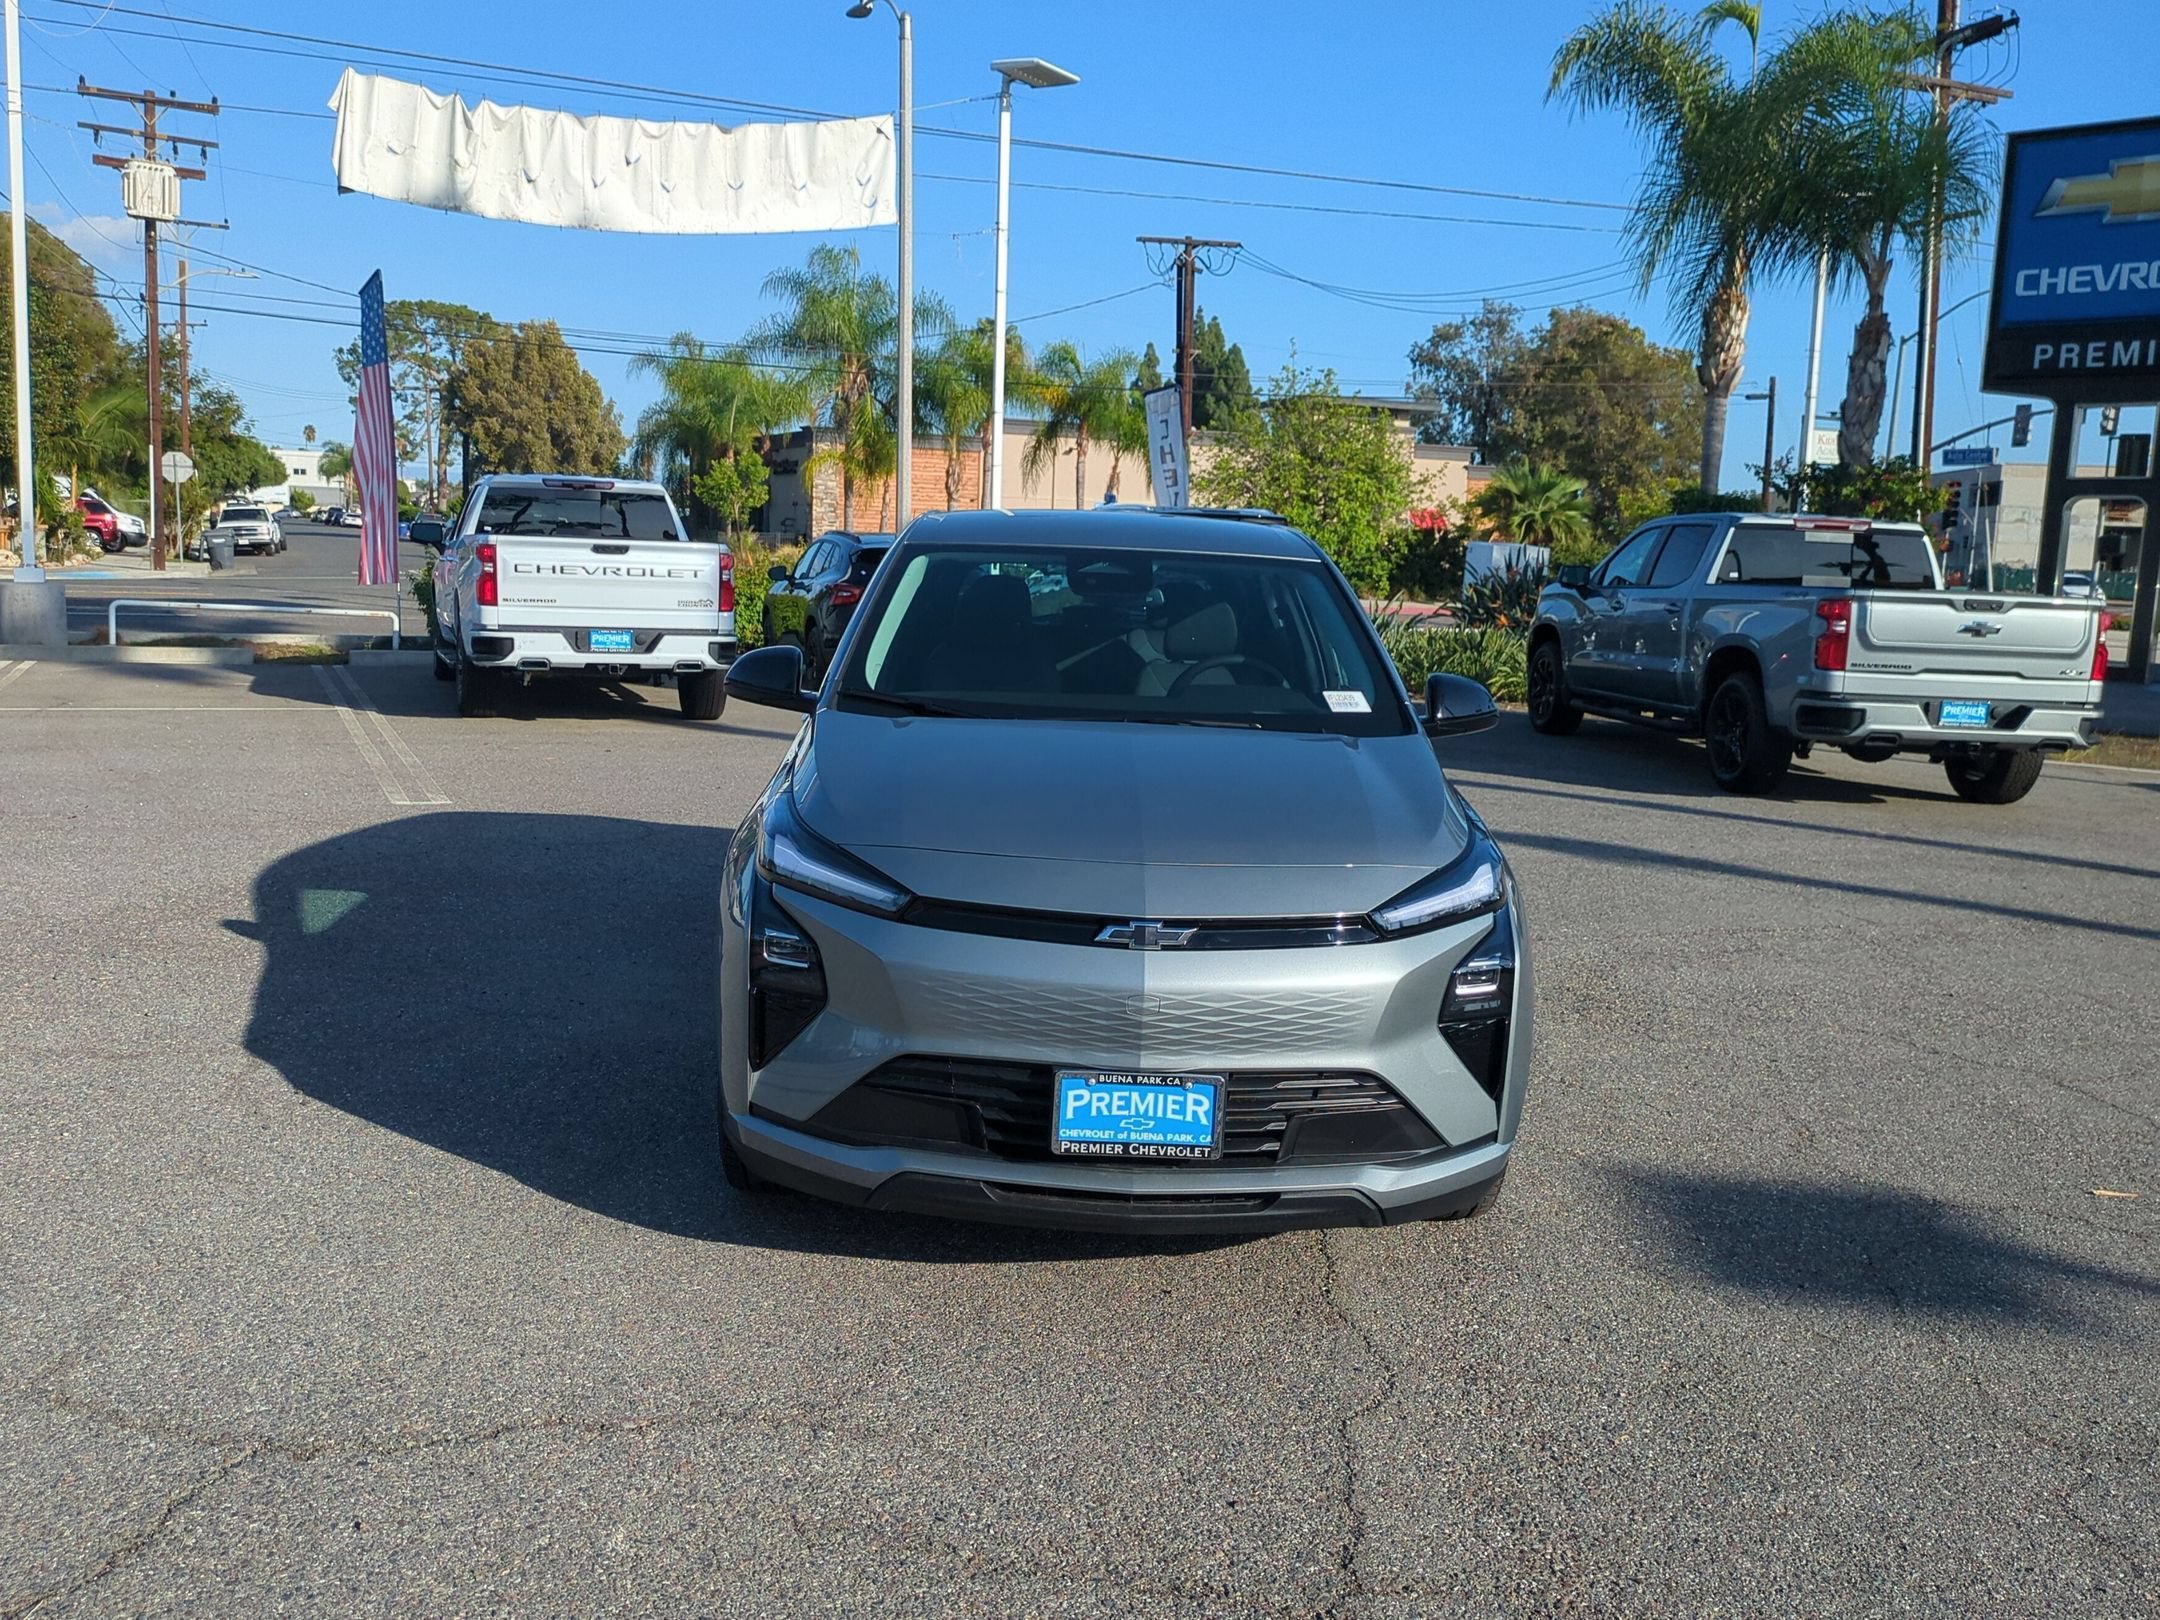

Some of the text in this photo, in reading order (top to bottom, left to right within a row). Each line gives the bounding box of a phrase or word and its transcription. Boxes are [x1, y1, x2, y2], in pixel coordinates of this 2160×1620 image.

[514, 563, 705, 579] CHEVROLET
[592, 634, 630, 644] PREMIER
[1850, 662, 1912, 670] SILVERADO
[1943, 705, 1986, 717] PREMIER
[1099, 1075, 1181, 1086] BUENA PARK, CA
[1066, 1089, 1210, 1126] PREMIER
[1060, 1128, 1115, 1139] CHEVROLET
[1117, 1131, 1128, 1139] of
[1130, 1131, 1164, 1141] BUENA
[1167, 1133, 1197, 1144] PARK,
[1060, 1141, 1211, 1158] PREMIER CHEVROLET
